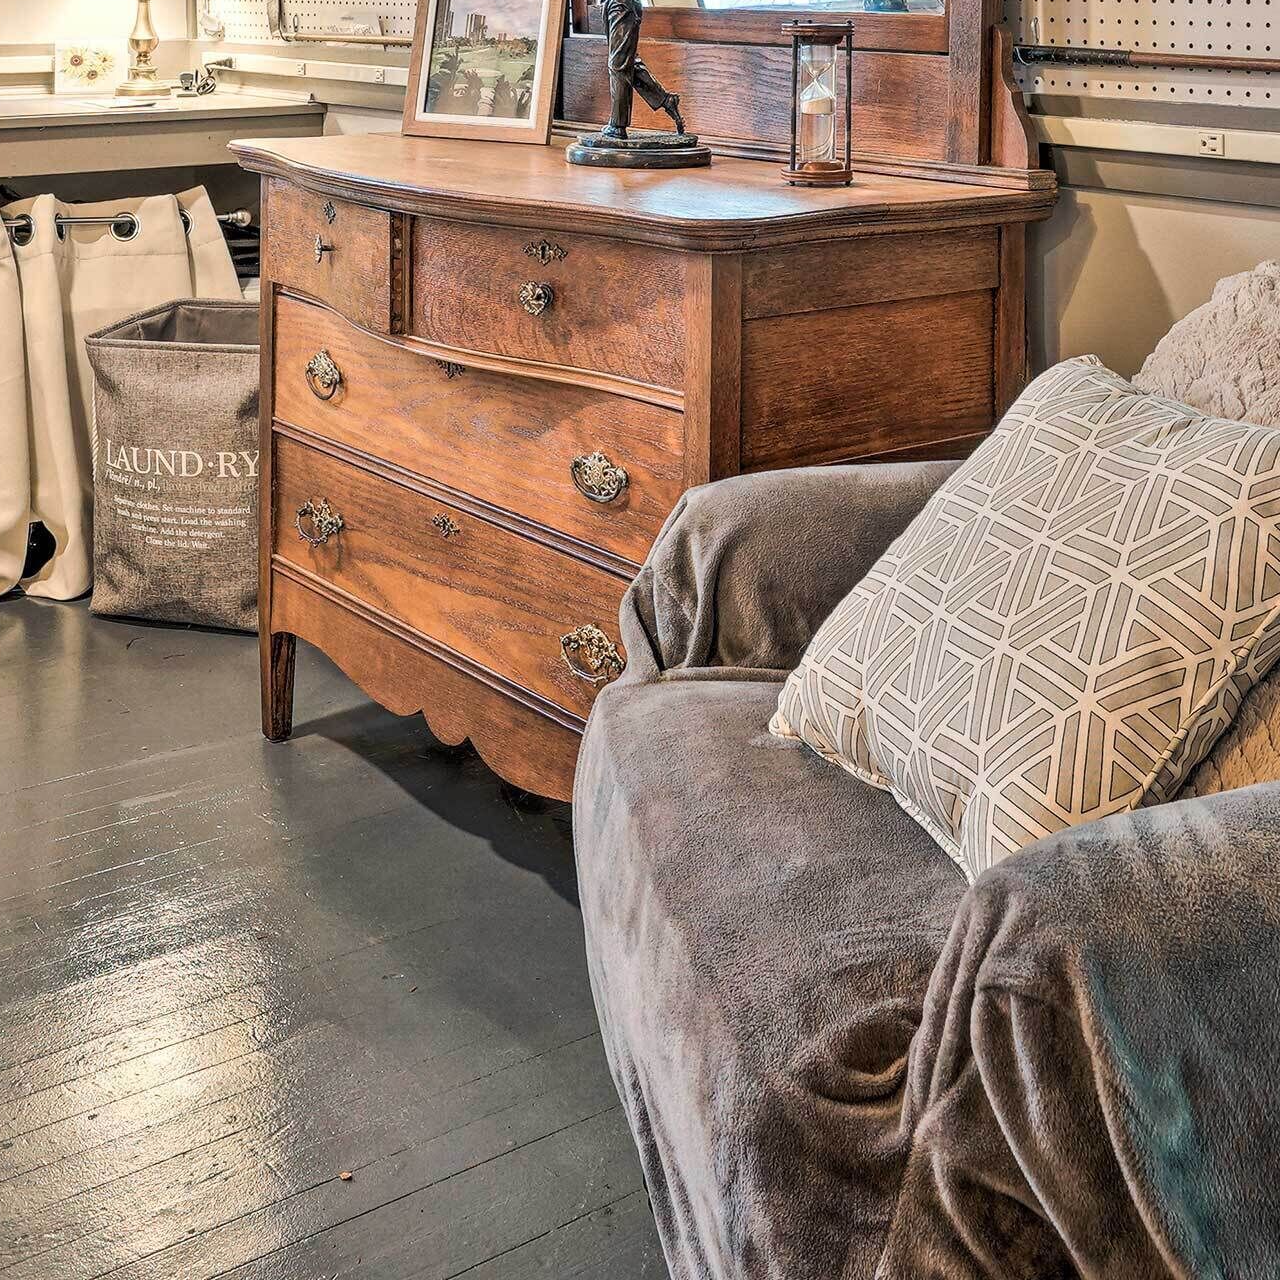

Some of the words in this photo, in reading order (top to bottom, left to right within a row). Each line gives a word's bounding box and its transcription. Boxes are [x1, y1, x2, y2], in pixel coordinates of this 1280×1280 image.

[175, 505, 206, 515] machine
[217, 504, 251, 515] standard
[180, 517, 199, 525] Load
[200, 517, 213, 526] the
[214, 518, 247, 528] washing
[160, 527, 175, 536] Add
[176, 528, 188, 537] the
[188, 528, 226, 539] detergent.
[145, 535, 163, 546] Close
[164, 538, 176, 547] the
